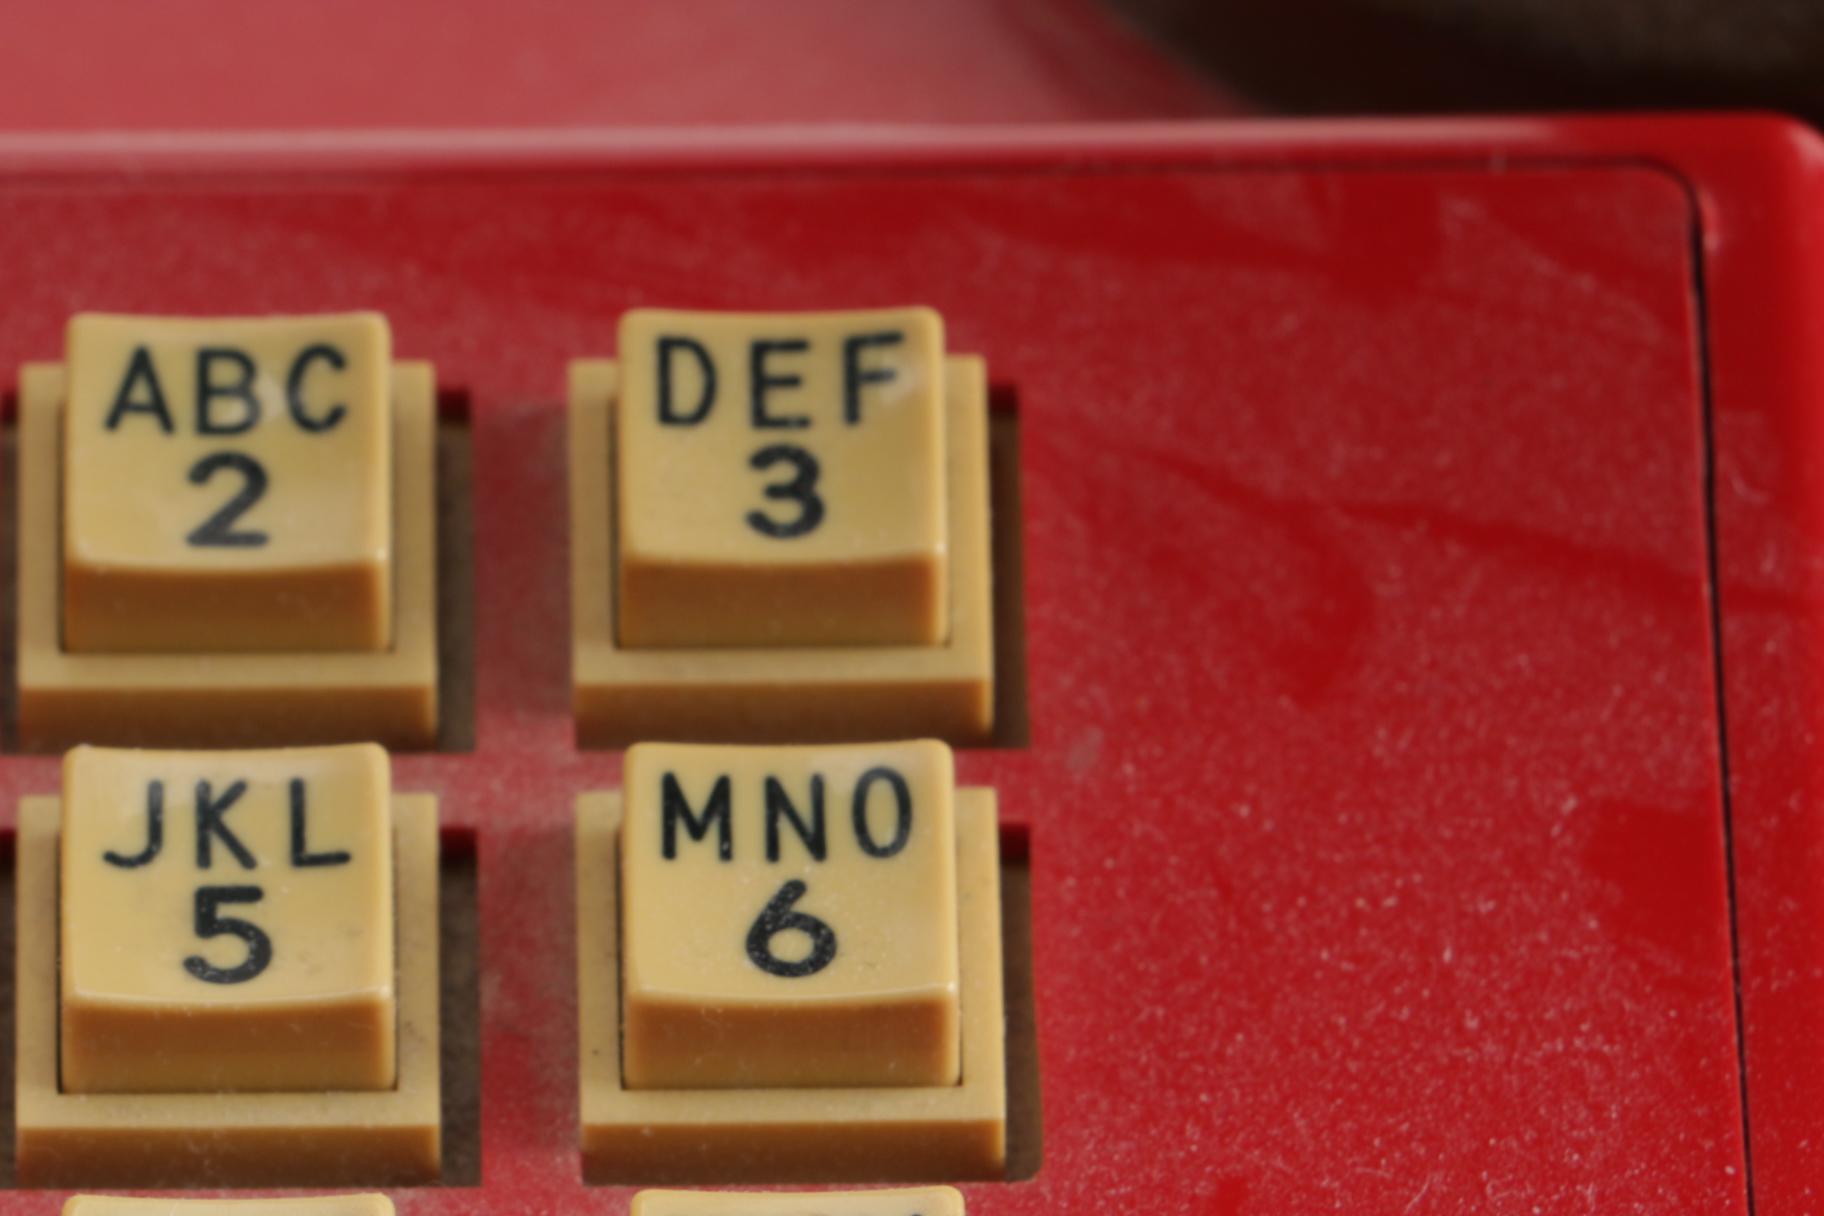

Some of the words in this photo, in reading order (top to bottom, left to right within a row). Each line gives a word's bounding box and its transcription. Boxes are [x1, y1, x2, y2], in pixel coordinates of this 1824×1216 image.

[101, 339, 352, 441] ABC
[652, 326, 909, 435] DEF
[184, 446, 273, 551] 2
[742, 438, 830, 543] 3
[100, 775, 355, 873] JKL
[658, 763, 916, 867] MNO
[180, 881, 276, 987] 5
[742, 876, 841, 981] 6
